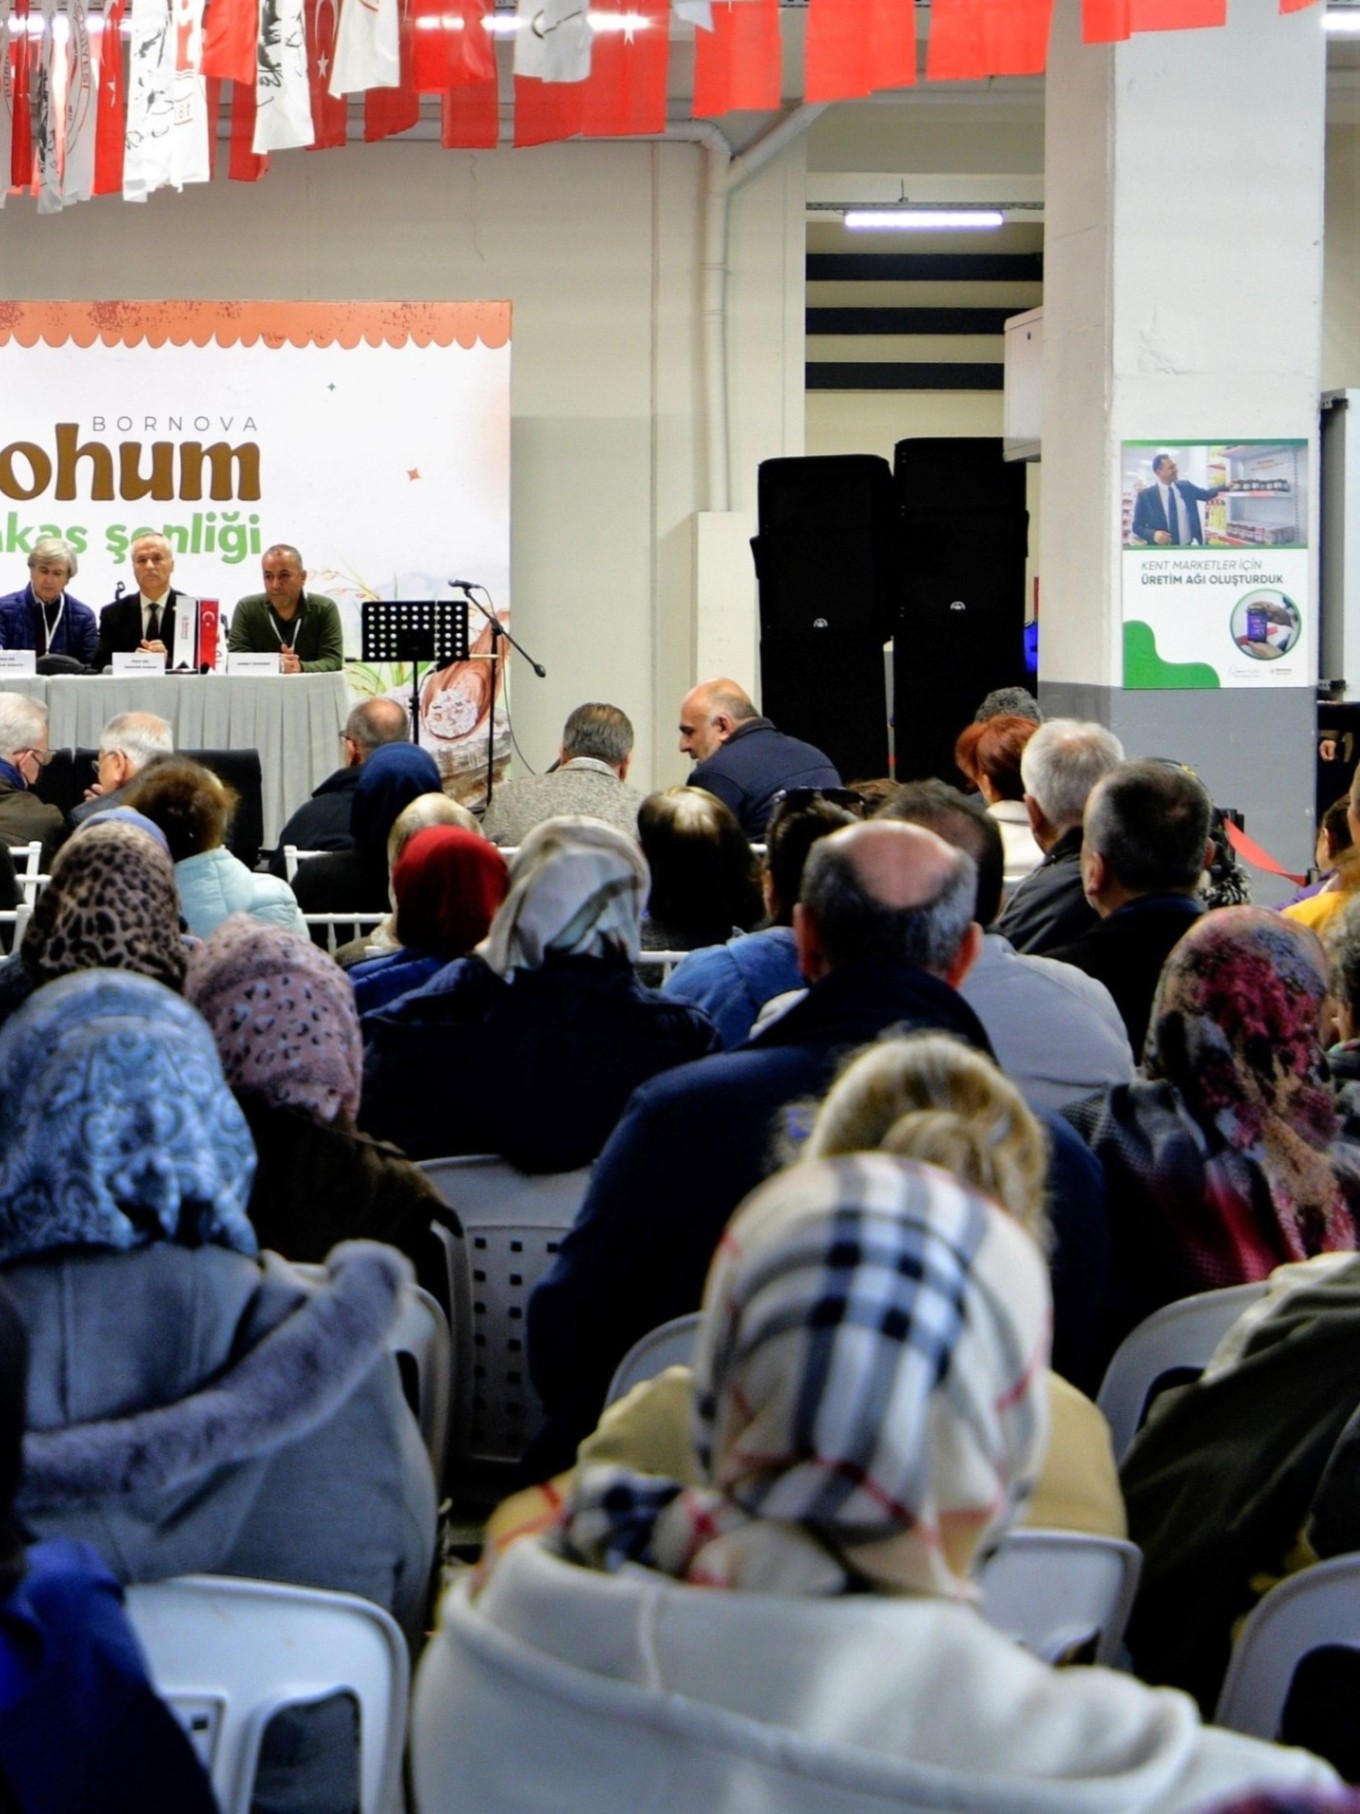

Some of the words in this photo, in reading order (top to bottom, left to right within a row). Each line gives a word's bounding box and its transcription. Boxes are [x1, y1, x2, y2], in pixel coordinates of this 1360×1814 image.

[92, 416, 258, 432] BORNOVA
[1141, 560, 1170, 571] KENT
[1172, 560, 1236, 571] MARKETLER
[1141, 573, 1182, 585] ÜRETİM
[1186, 573, 1206, 585] AĞI
[1209, 573, 1284, 587] OLUŞTURDUK
